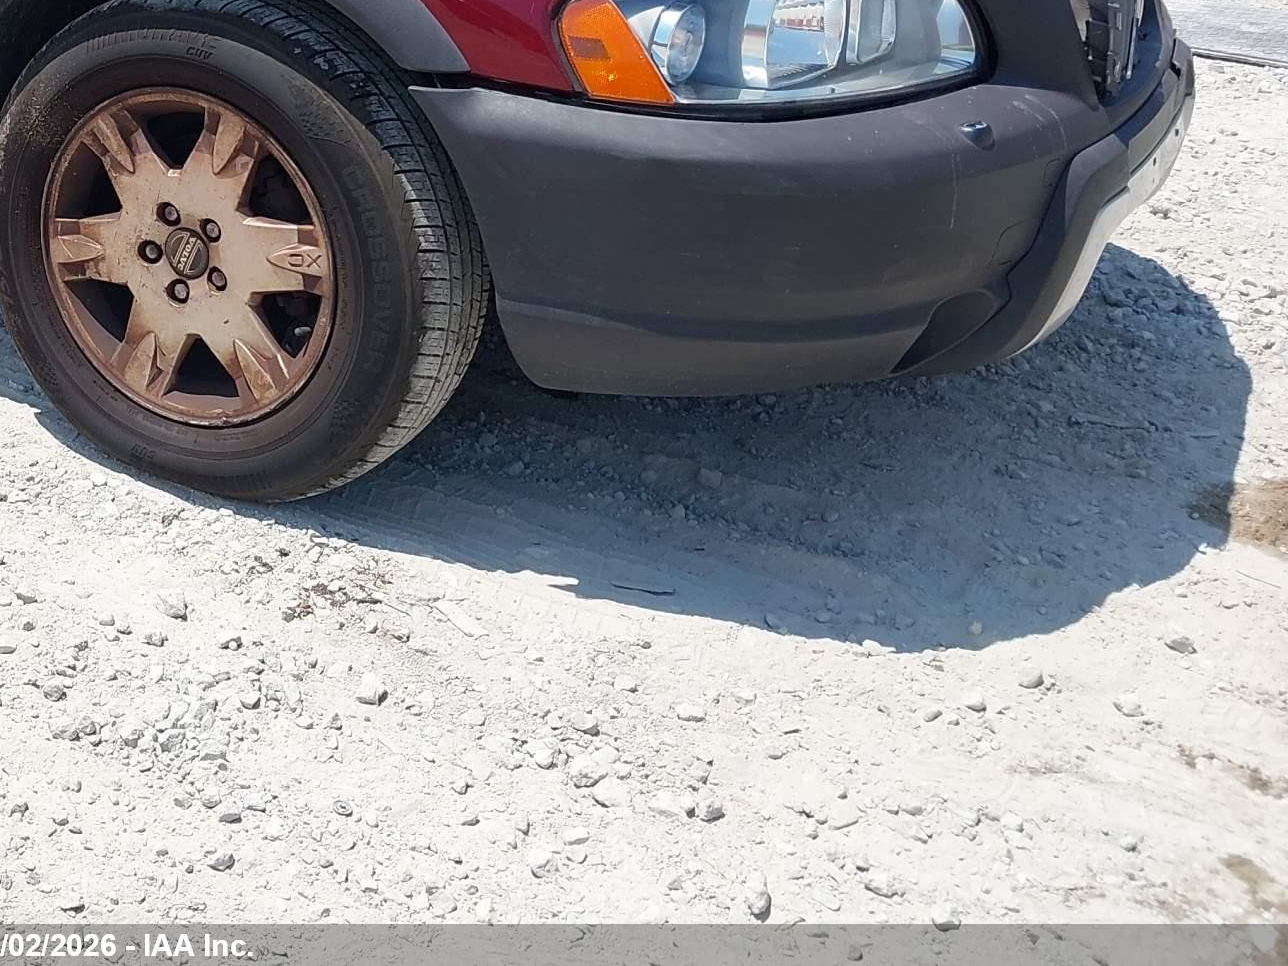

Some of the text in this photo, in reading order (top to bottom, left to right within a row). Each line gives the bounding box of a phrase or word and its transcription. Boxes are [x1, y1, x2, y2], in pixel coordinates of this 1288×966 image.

[186, 46, 214, 60] CUV
[177, 237, 198, 271] VOLVO
[287, 253, 323, 269] XC
[342, 165, 391, 372] CROSSOVER
